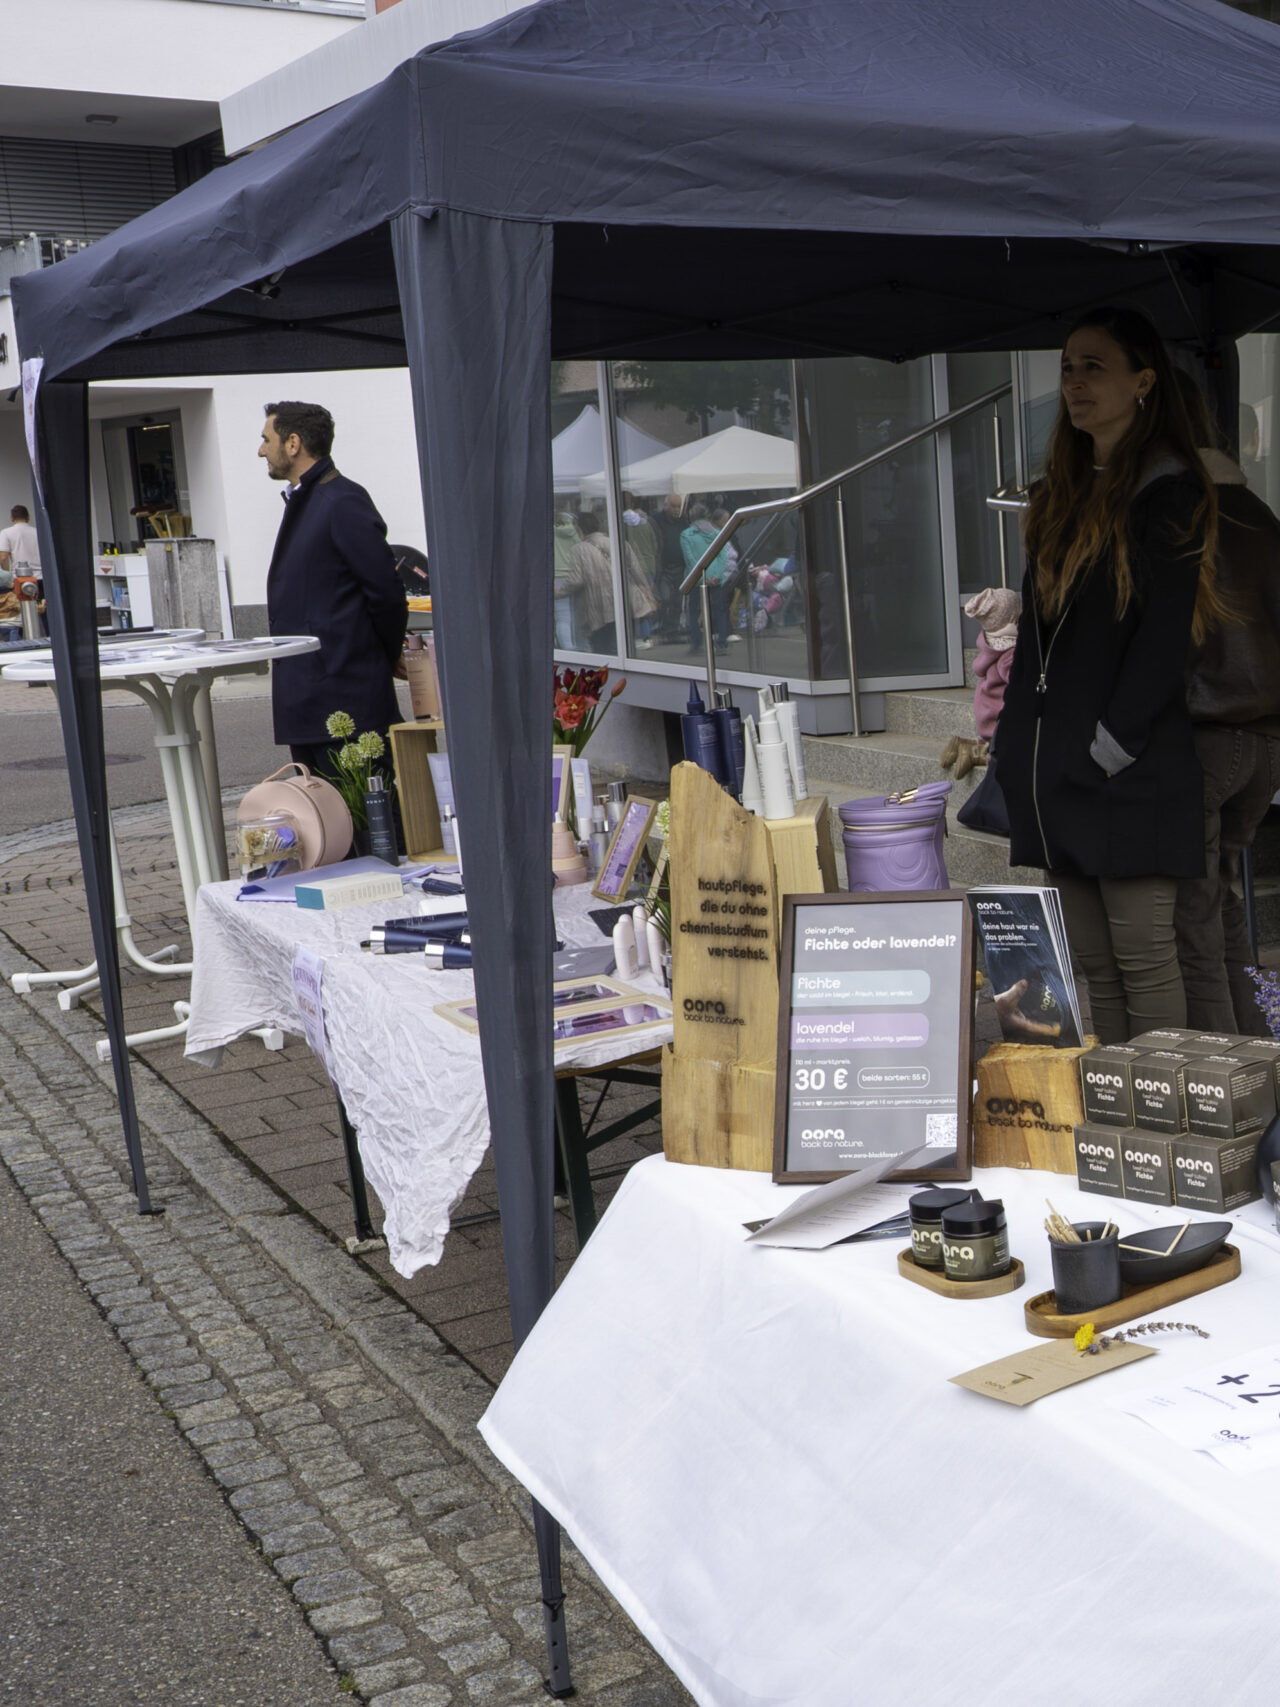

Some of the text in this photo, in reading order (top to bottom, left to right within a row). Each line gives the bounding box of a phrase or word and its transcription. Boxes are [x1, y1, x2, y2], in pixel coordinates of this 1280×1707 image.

[698, 878, 767, 897] hautpflege,
[701, 900, 768, 916] die du ohne
[680, 921, 769, 938] chemiestudium
[805, 926, 856, 936] deine pflege.
[805, 935, 957, 951] fichte oder lavendel?
[708, 946, 769, 961] verstehst.
[798, 977, 841, 990] fichte
[796, 1021, 855, 1034] lavendel
[795, 1068, 848, 1091] 30 €
[1018, 1117, 1032, 1128] to
[801, 1140, 821, 1148] back
[823, 1140, 833, 1148] to
